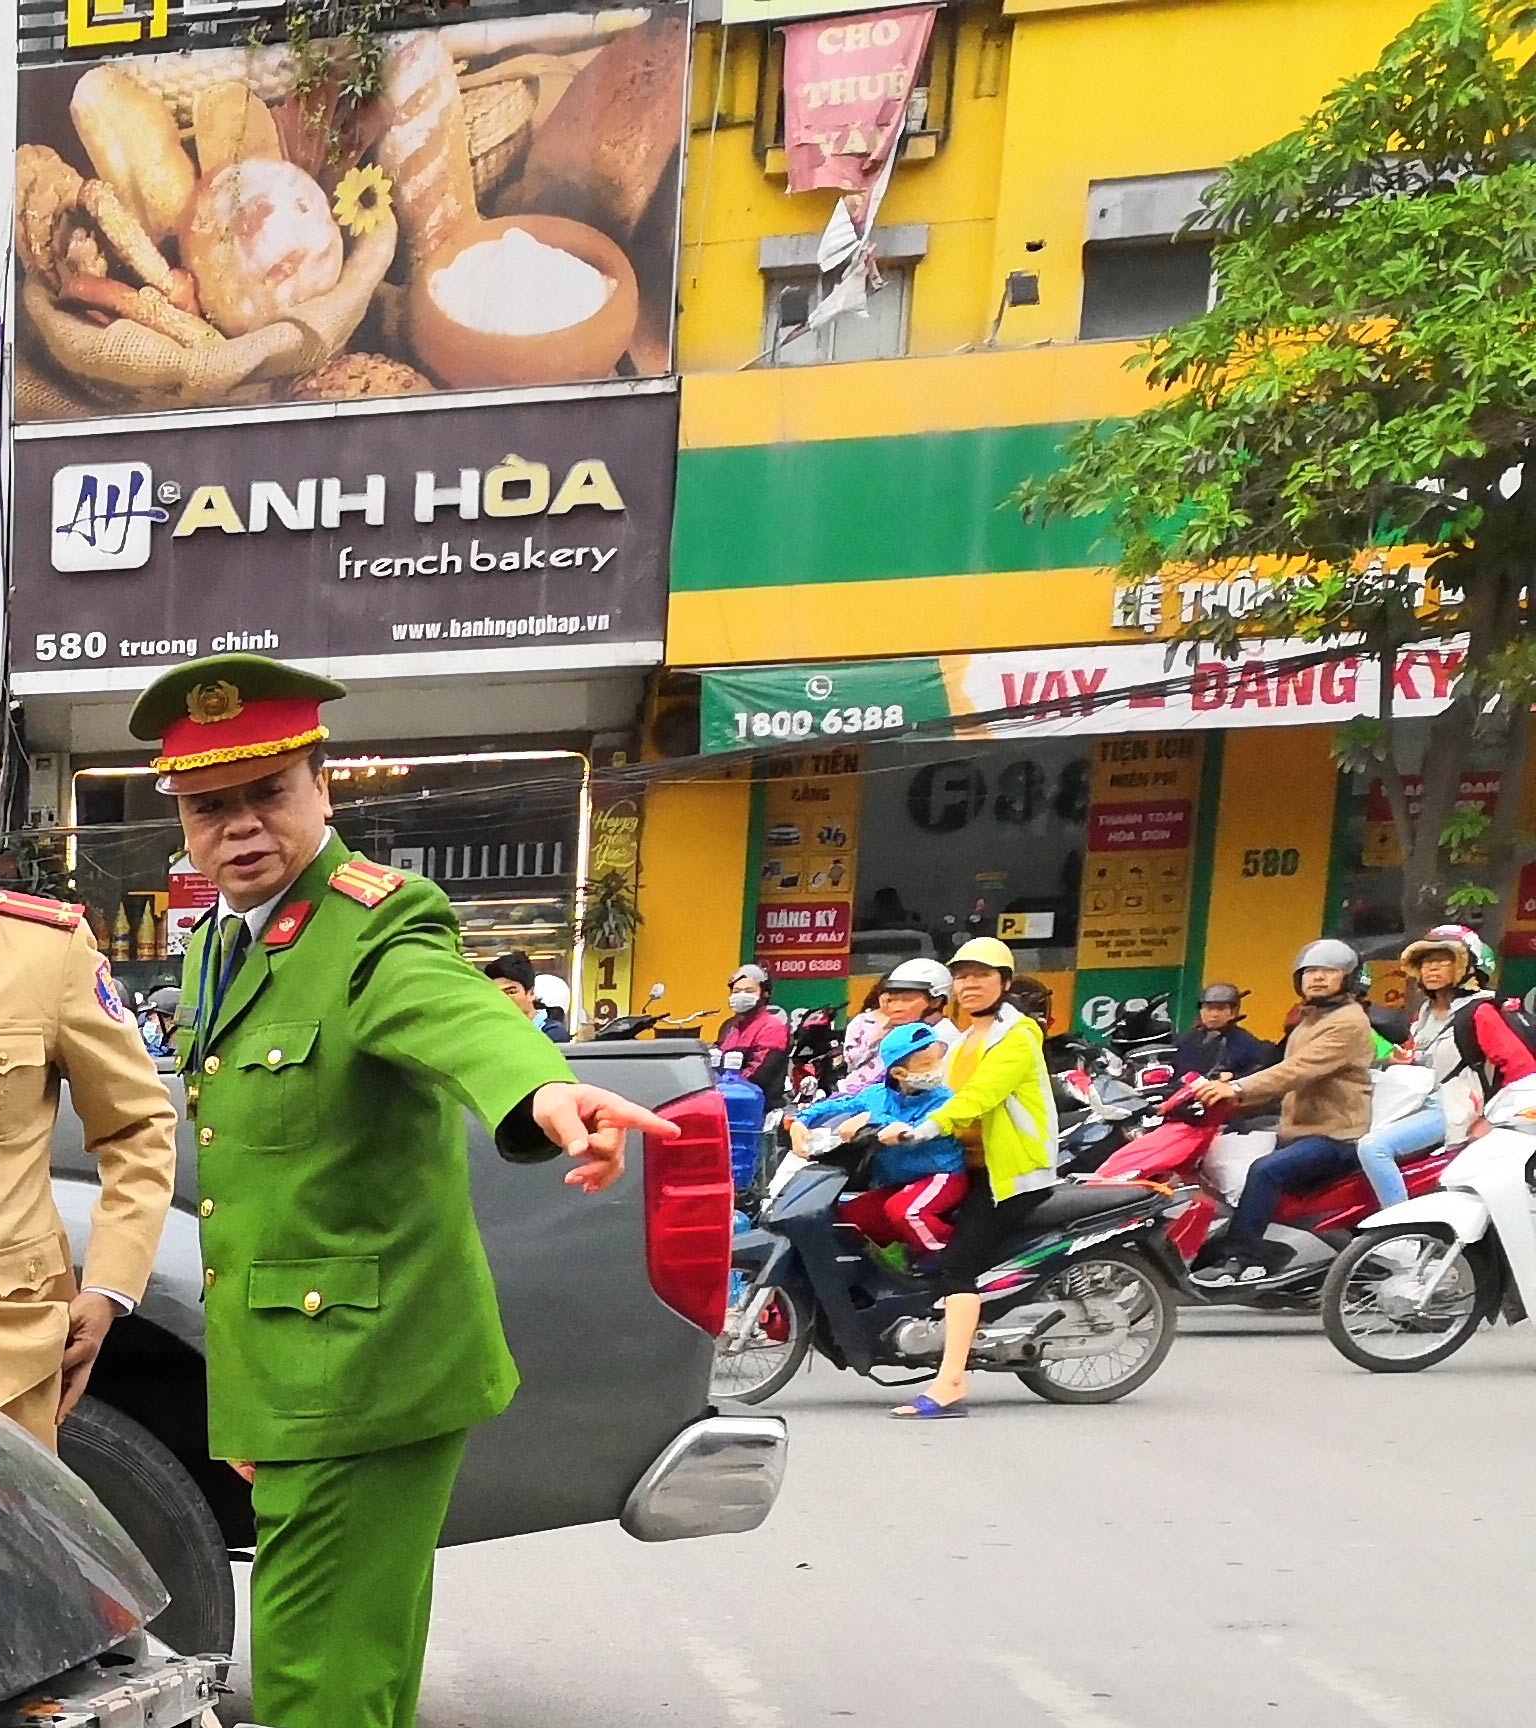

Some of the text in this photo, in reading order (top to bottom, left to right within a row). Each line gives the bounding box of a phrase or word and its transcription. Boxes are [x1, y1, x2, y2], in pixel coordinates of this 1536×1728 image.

[817, 18, 901, 55] CHO
[802, 63, 910, 109] THUÊ
[172, 453, 627, 538] ANH HÒA
[338, 537, 618, 582] french bakery
[1112, 575, 1162, 633] HỆ
[35, 612, 610, 662] 580 truong chinh www.banhngotphap.vn
[734, 710, 812, 738] 1800
[821, 705, 904, 734] 6388
[1001, 668, 1108, 720] VAY
[1242, 848, 1300, 878] 580
[774, 960, 806, 972] 1800
